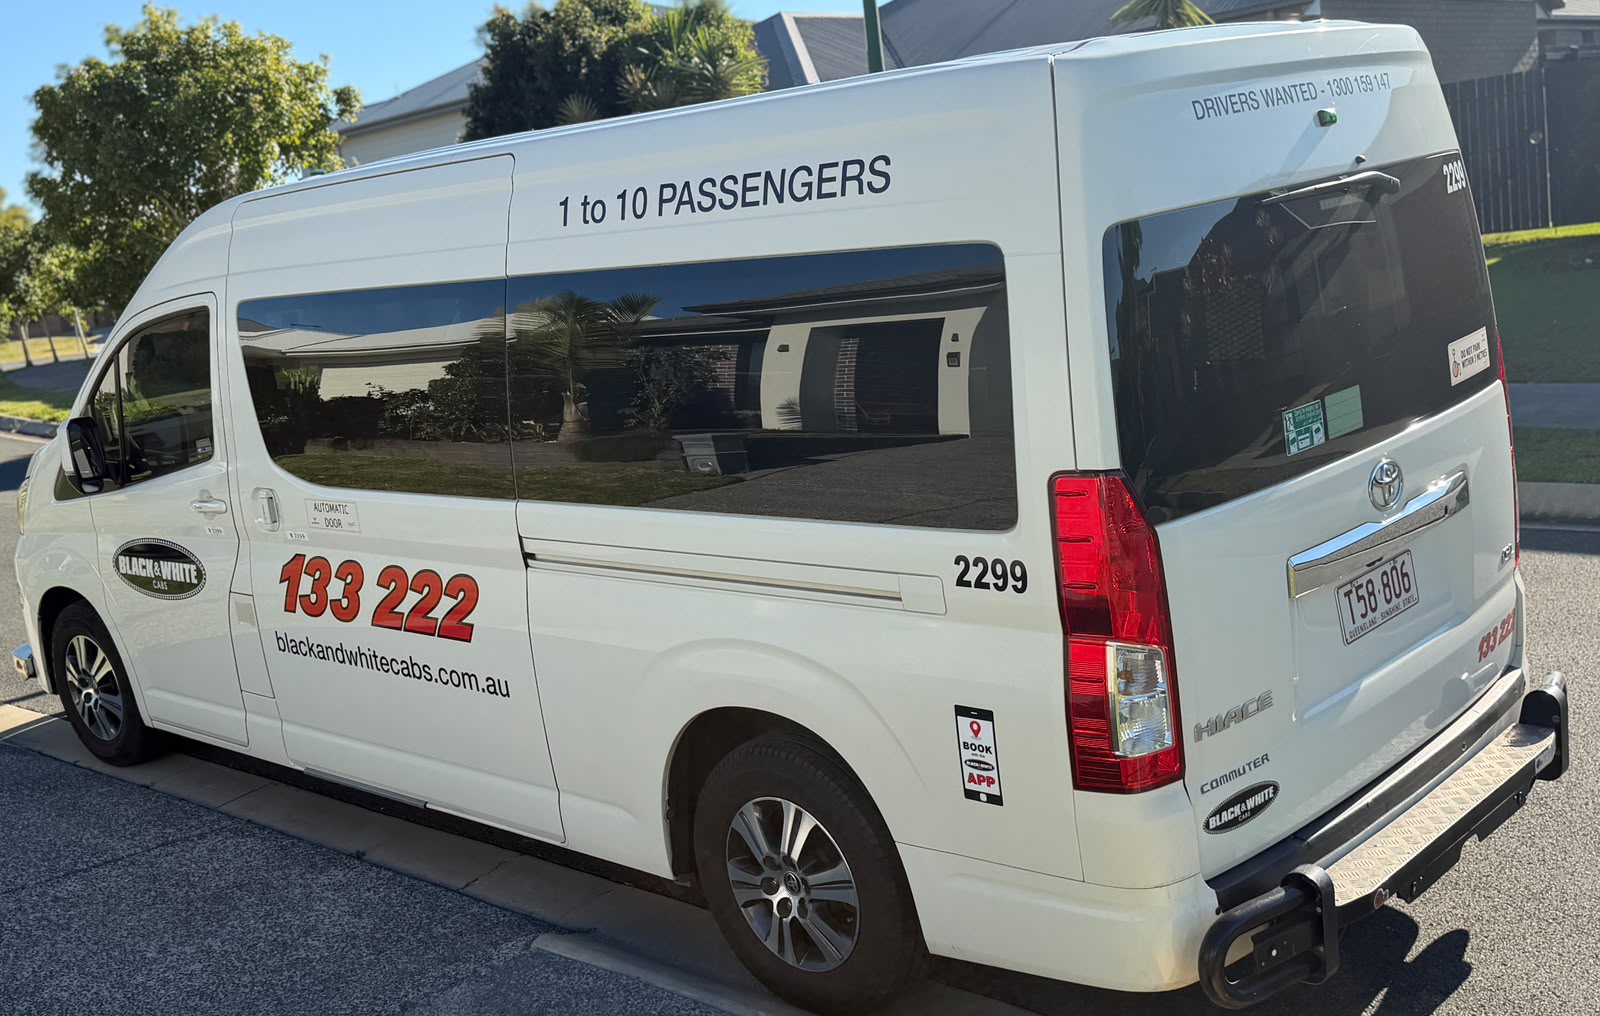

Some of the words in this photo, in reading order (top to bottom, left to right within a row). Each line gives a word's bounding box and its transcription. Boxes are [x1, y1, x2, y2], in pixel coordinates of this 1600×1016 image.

[1191, 90, 1260, 121] DRIVERS
[1259, 81, 1318, 108] WANTED
[1326, 76, 1354, 98] 1300
[1354, 74, 1374, 92] 159
[1374, 72, 1391, 91] 147
[558, 195, 570, 227] 1
[580, 194, 606, 225] to
[616, 186, 648, 221] 10
[658, 154, 892, 217] PASSENGERS
[1442, 159, 1466, 194] 2299
[313, 502, 349, 515] AUTOMATIC
[324, 517, 343, 529] DOOR
[152, 579, 168, 591] CABS
[954, 554, 1028, 594] 2299
[279, 553, 365, 623] 133
[371, 564, 480, 644] 222
[1348, 616, 1378, 640] QUEENSLAND
[1380, 602, 1403, 621] SUNSHINE
[1402, 594, 1416, 608] STATE
[1478, 625, 1499, 663] 133
[275, 630, 511, 698] blackandwhitecabs.com.au
[1193, 689, 1274, 743] HIACE
[962, 741, 993, 755] BOOK
[967, 772, 996, 787] APP
[1200, 753, 1271, 795] COMMUTER
[1238, 811, 1251, 822] CABS
